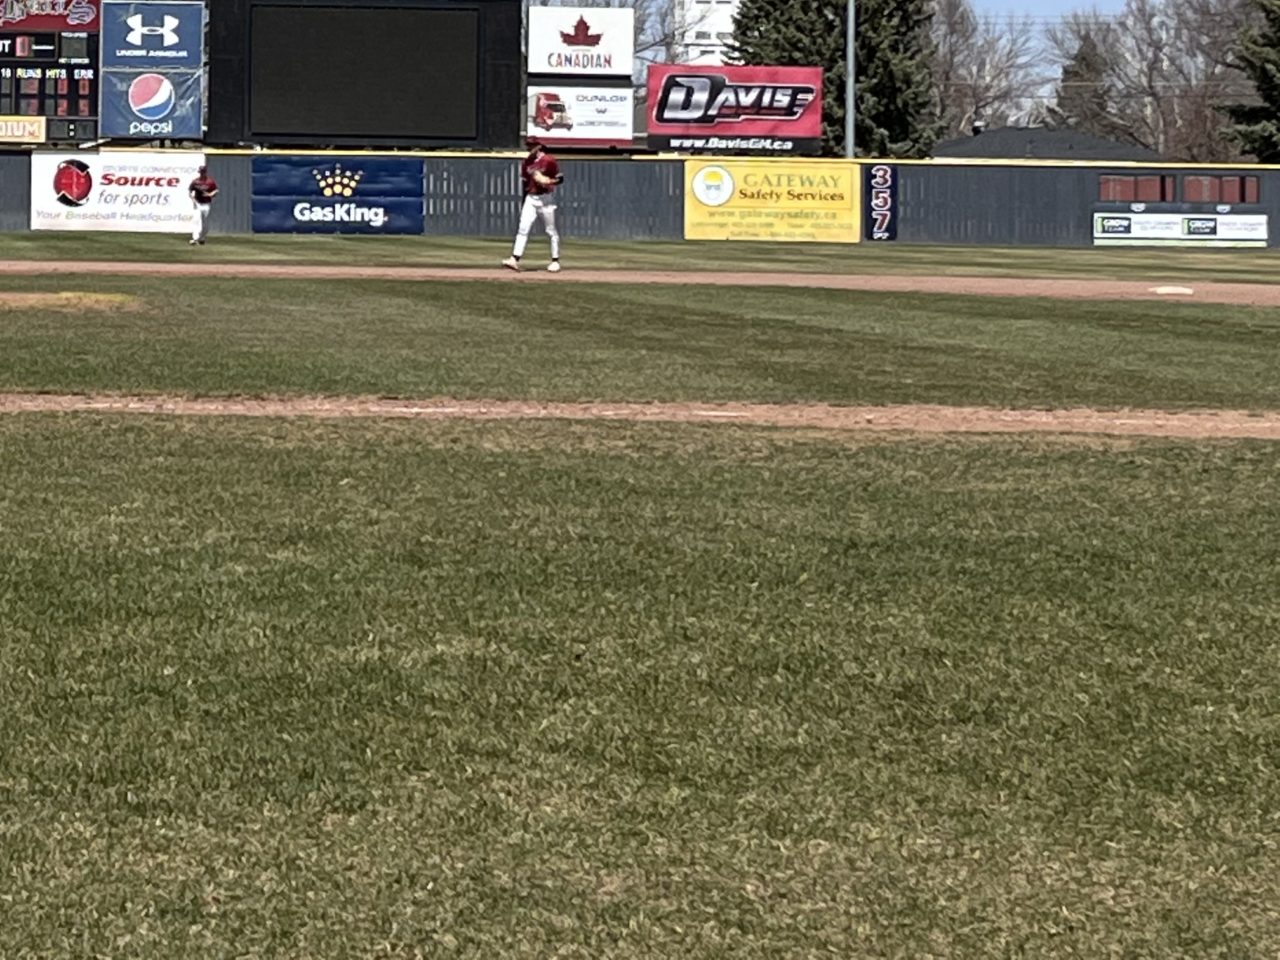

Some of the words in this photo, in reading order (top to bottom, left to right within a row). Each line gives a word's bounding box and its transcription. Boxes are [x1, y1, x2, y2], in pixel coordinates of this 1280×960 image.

[116, 49, 147, 57] UNDER
[547, 52, 612, 68] CANADIAN
[0, 68, 11, 78] 10
[16, 68, 42, 78] RUNS
[46, 68, 67, 79] HITS
[663, 77, 793, 120] DAVIS
[129, 121, 172, 134] pepsi
[670, 138, 793, 150] www.DavisGM.ca
[100, 173, 180, 188] Source
[743, 174, 841, 188] GATEWAY
[98, 190, 120, 205] for
[124, 192, 169, 207] sports
[739, 189, 783, 202] Safety
[787, 190, 845, 201] Services
[871, 165, 892, 232] 357
[36, 210, 61, 219] Your
[65, 211, 116, 219] Baseball
[120, 212, 194, 222] Headquarter
